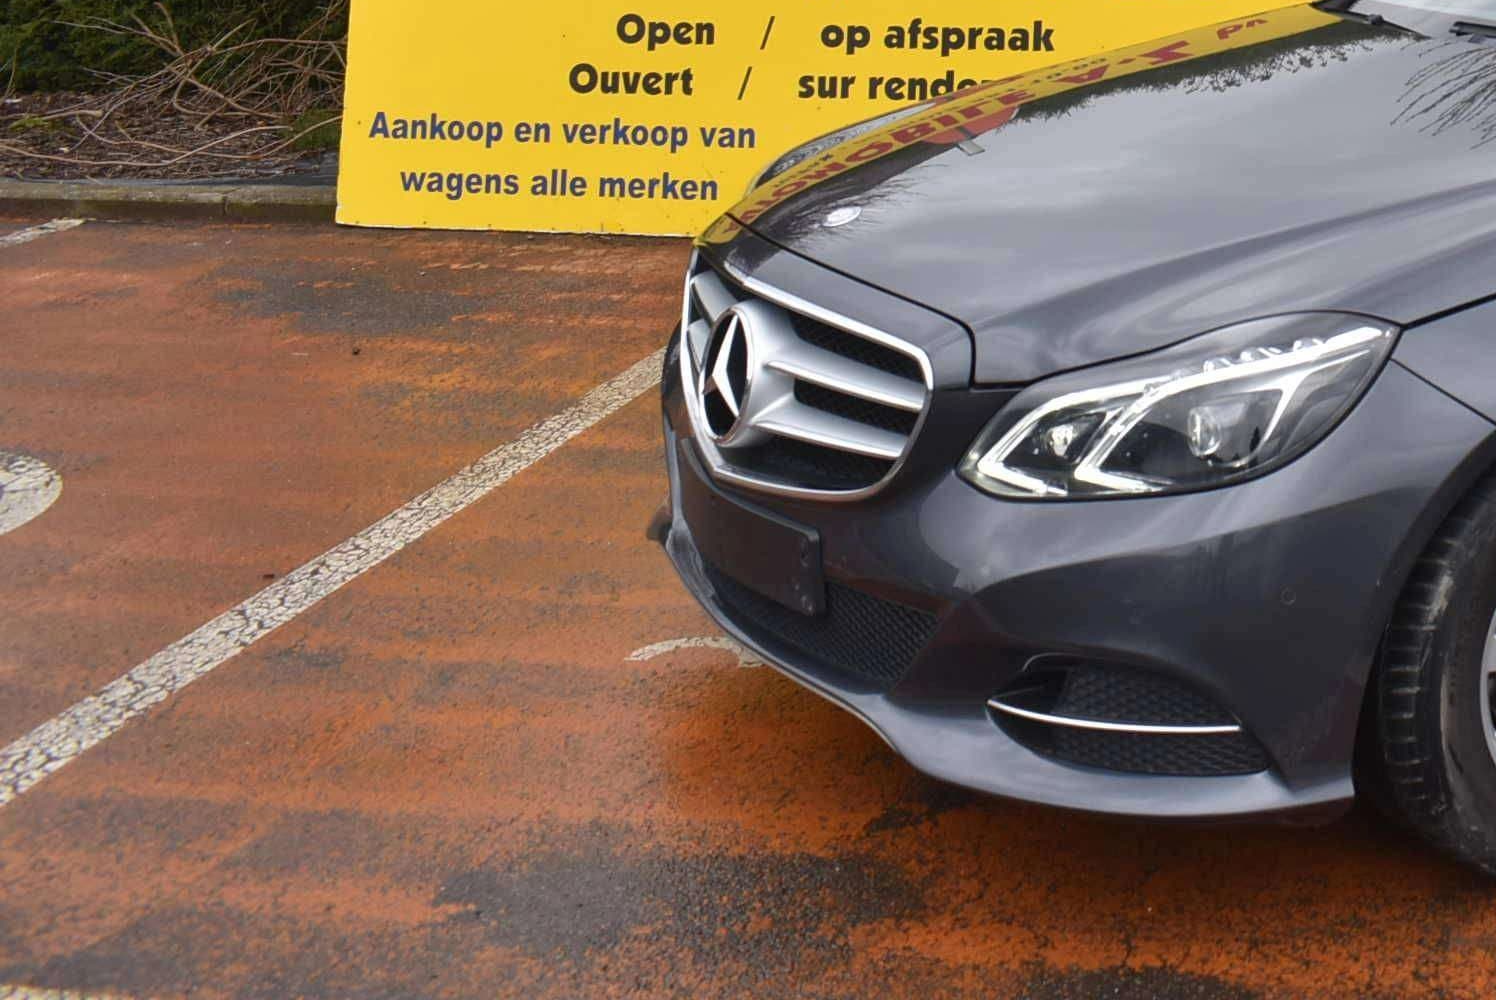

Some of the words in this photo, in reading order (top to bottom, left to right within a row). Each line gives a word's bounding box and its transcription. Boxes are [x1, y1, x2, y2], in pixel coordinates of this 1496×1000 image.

[616, 13, 715, 52] Open
[820, 24, 871, 56] op
[883, 17, 1055, 57] afspraak
[568, 62, 694, 96] Ouvert
[798, 75, 857, 99] sur
[868, 69, 993, 101] rend
[369, 111, 503, 150] Aankoop
[514, 122, 551, 143] en
[562, 117, 688, 154] verkoop
[699, 127, 755, 149] van
[400, 171, 519, 201] wagens
[530, 168, 587, 197] alle
[598, 171, 718, 201] merken
